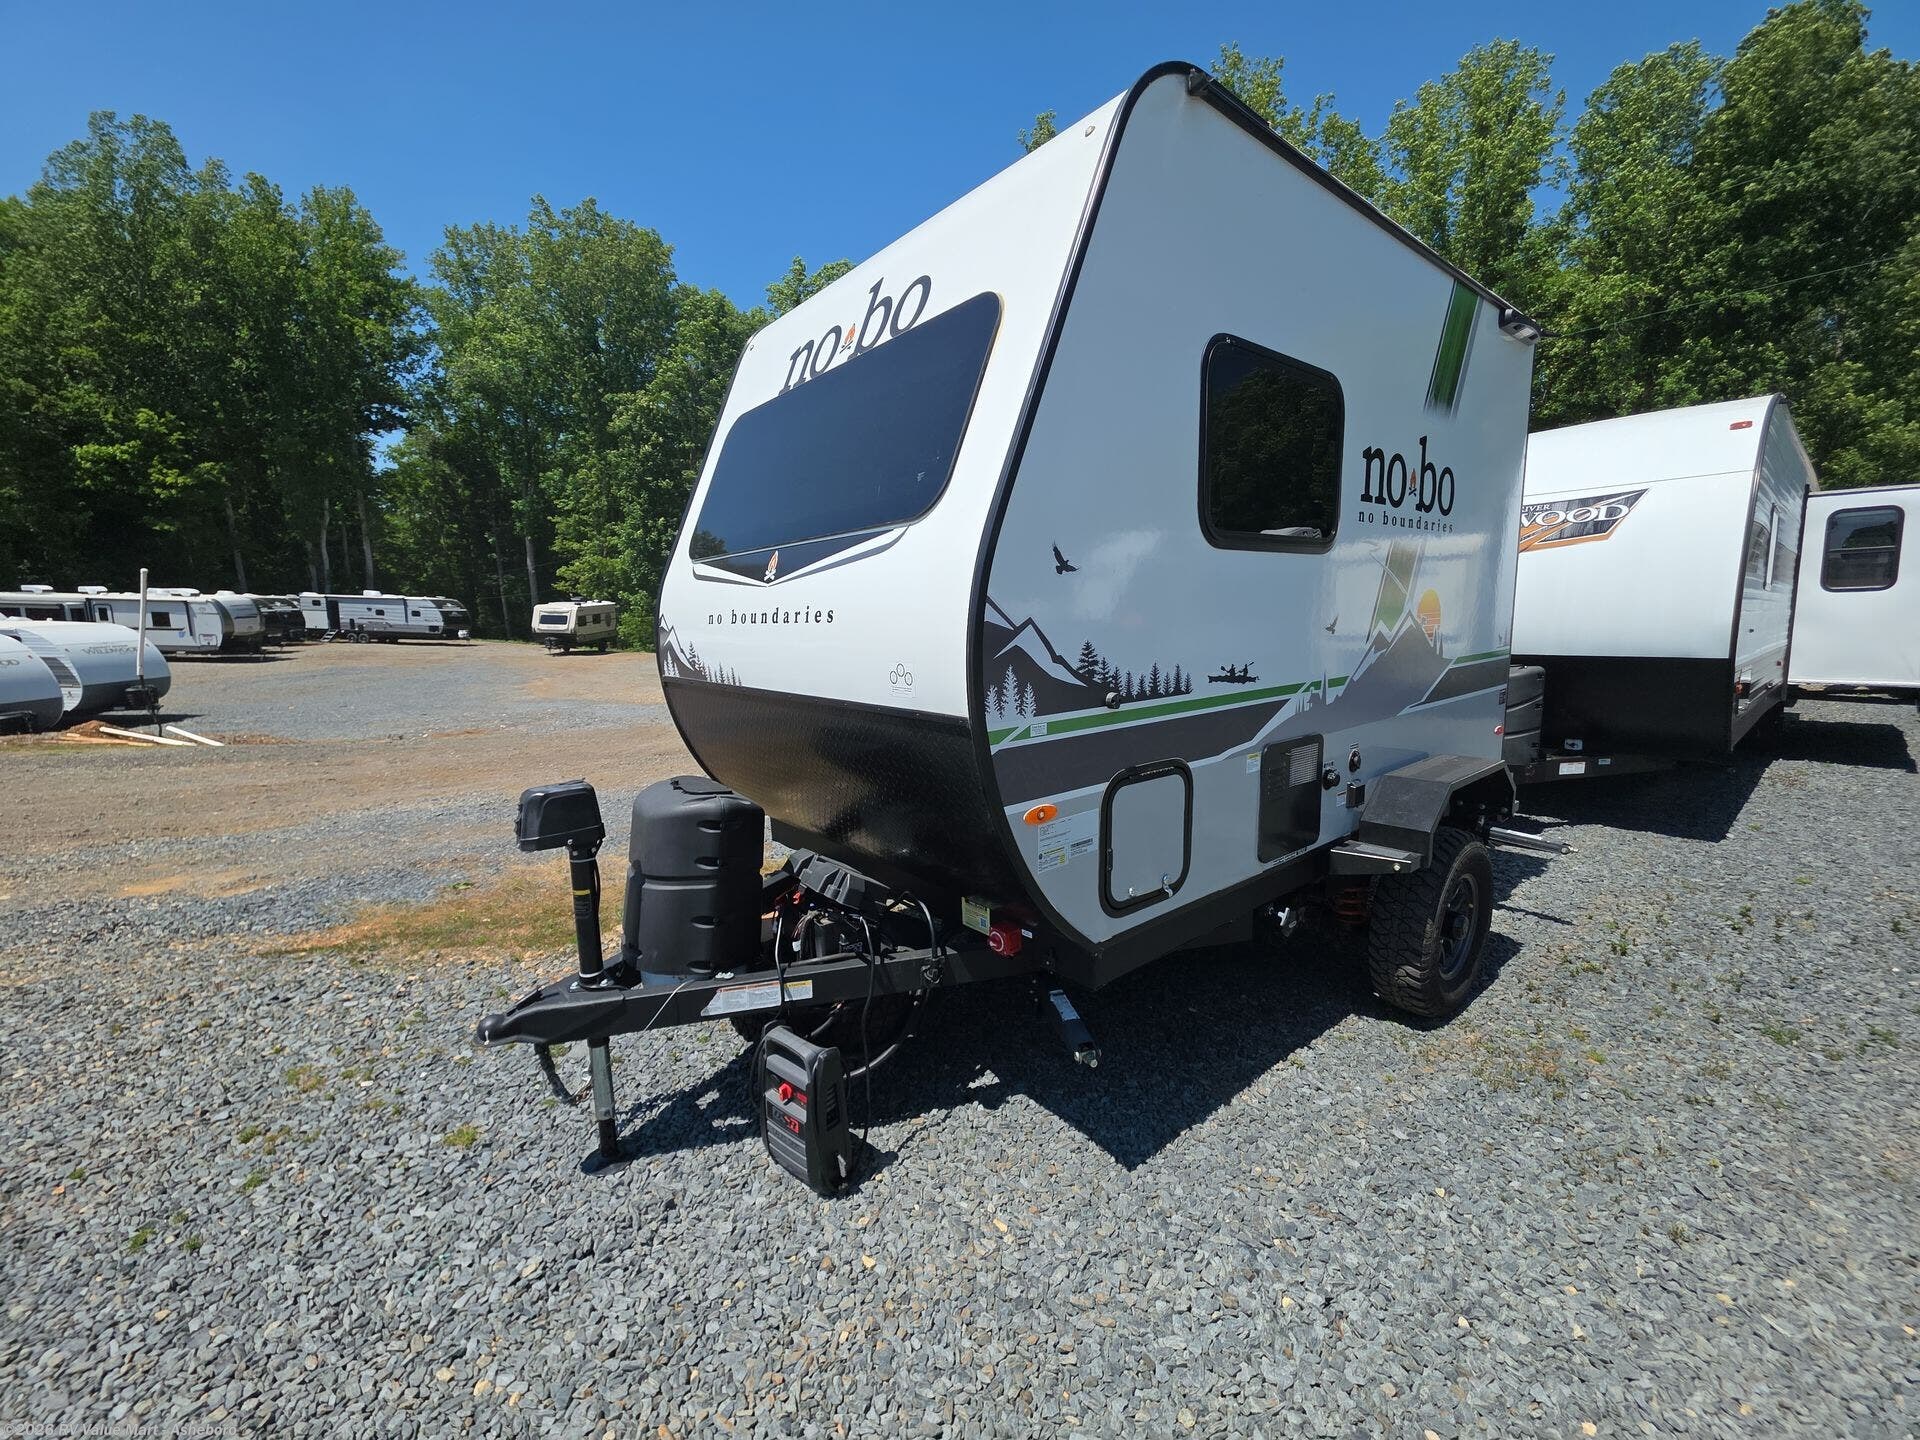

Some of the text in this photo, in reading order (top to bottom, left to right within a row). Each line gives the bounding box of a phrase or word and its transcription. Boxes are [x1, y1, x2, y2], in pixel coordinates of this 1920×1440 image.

[1358, 510, 1454, 534] no boundaries
[708, 605, 834, 625] no boundaries
